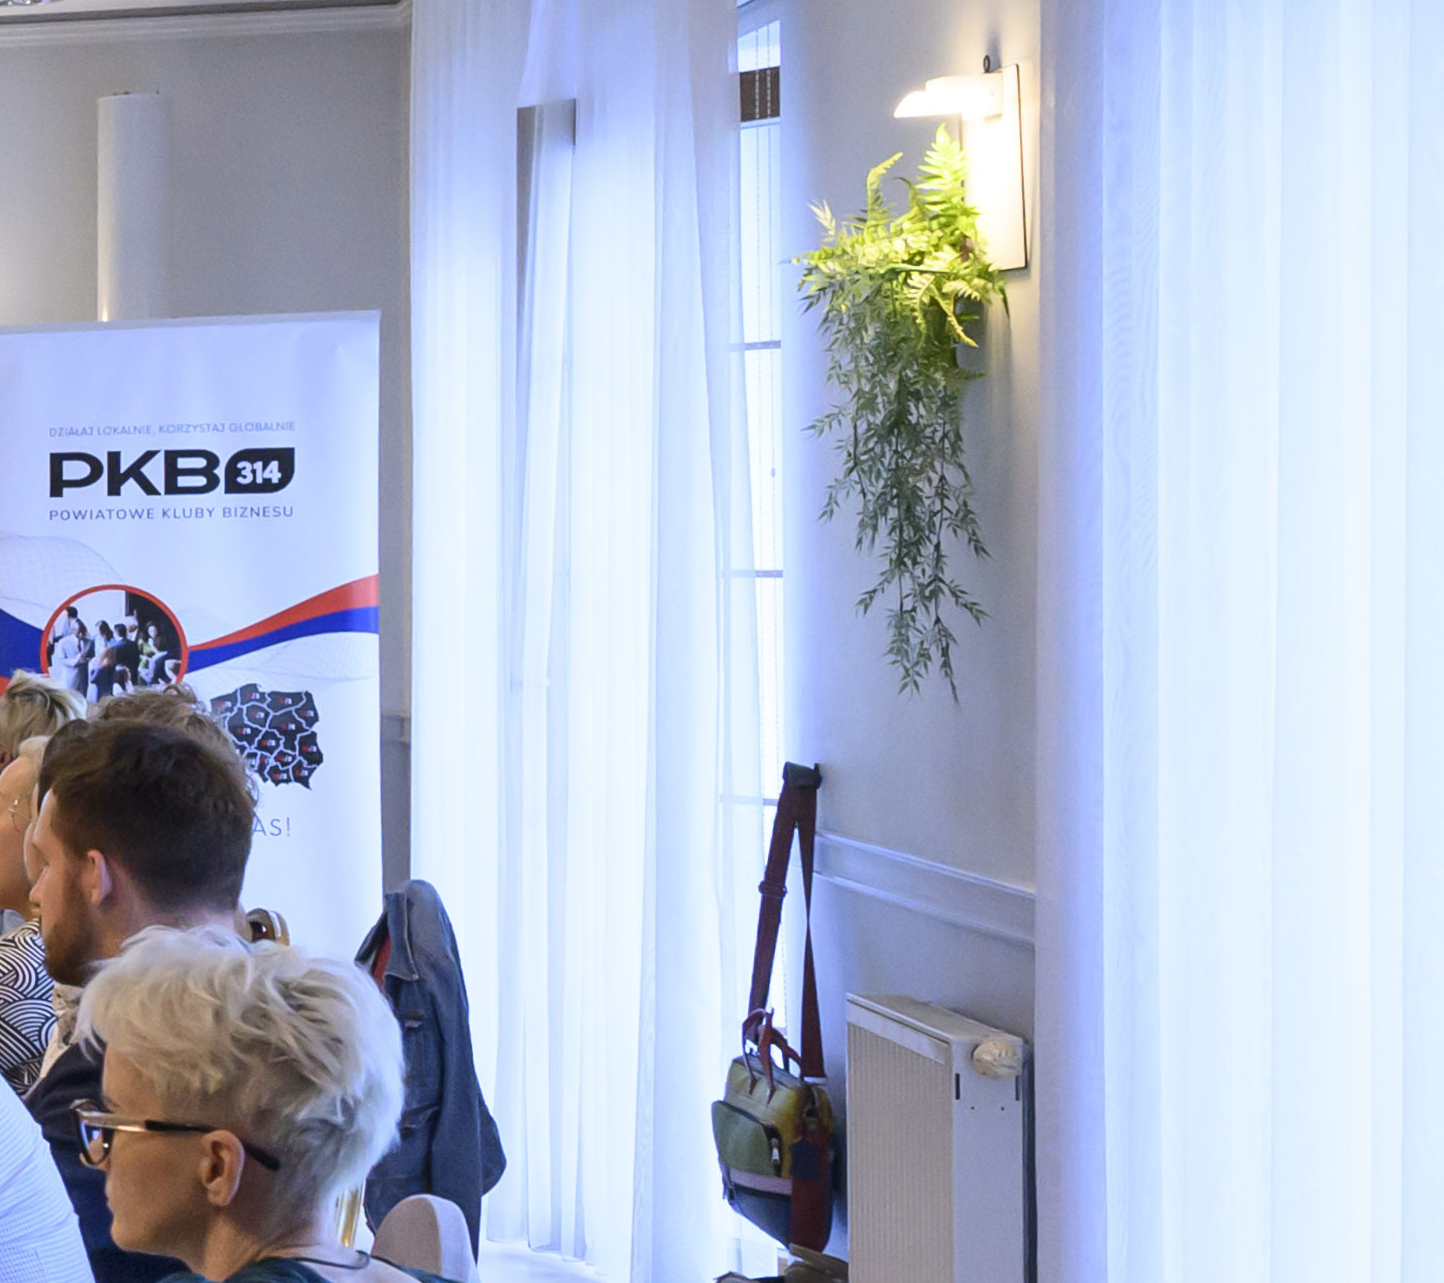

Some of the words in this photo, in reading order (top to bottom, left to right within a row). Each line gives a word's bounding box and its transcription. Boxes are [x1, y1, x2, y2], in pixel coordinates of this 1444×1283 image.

[49, 426, 94, 438] DZIAŁAJ
[158, 422, 225, 435] KORZYSTAJ
[228, 421, 296, 433] GLOBALNIE
[49, 449, 221, 498] PKB
[235, 460, 282, 485] 314
[49, 508, 155, 521] POWIATOWE
[162, 507, 215, 519] KLUBY
[222, 505, 294, 519] BIZNESU
[252, 817, 290, 837] AS!
